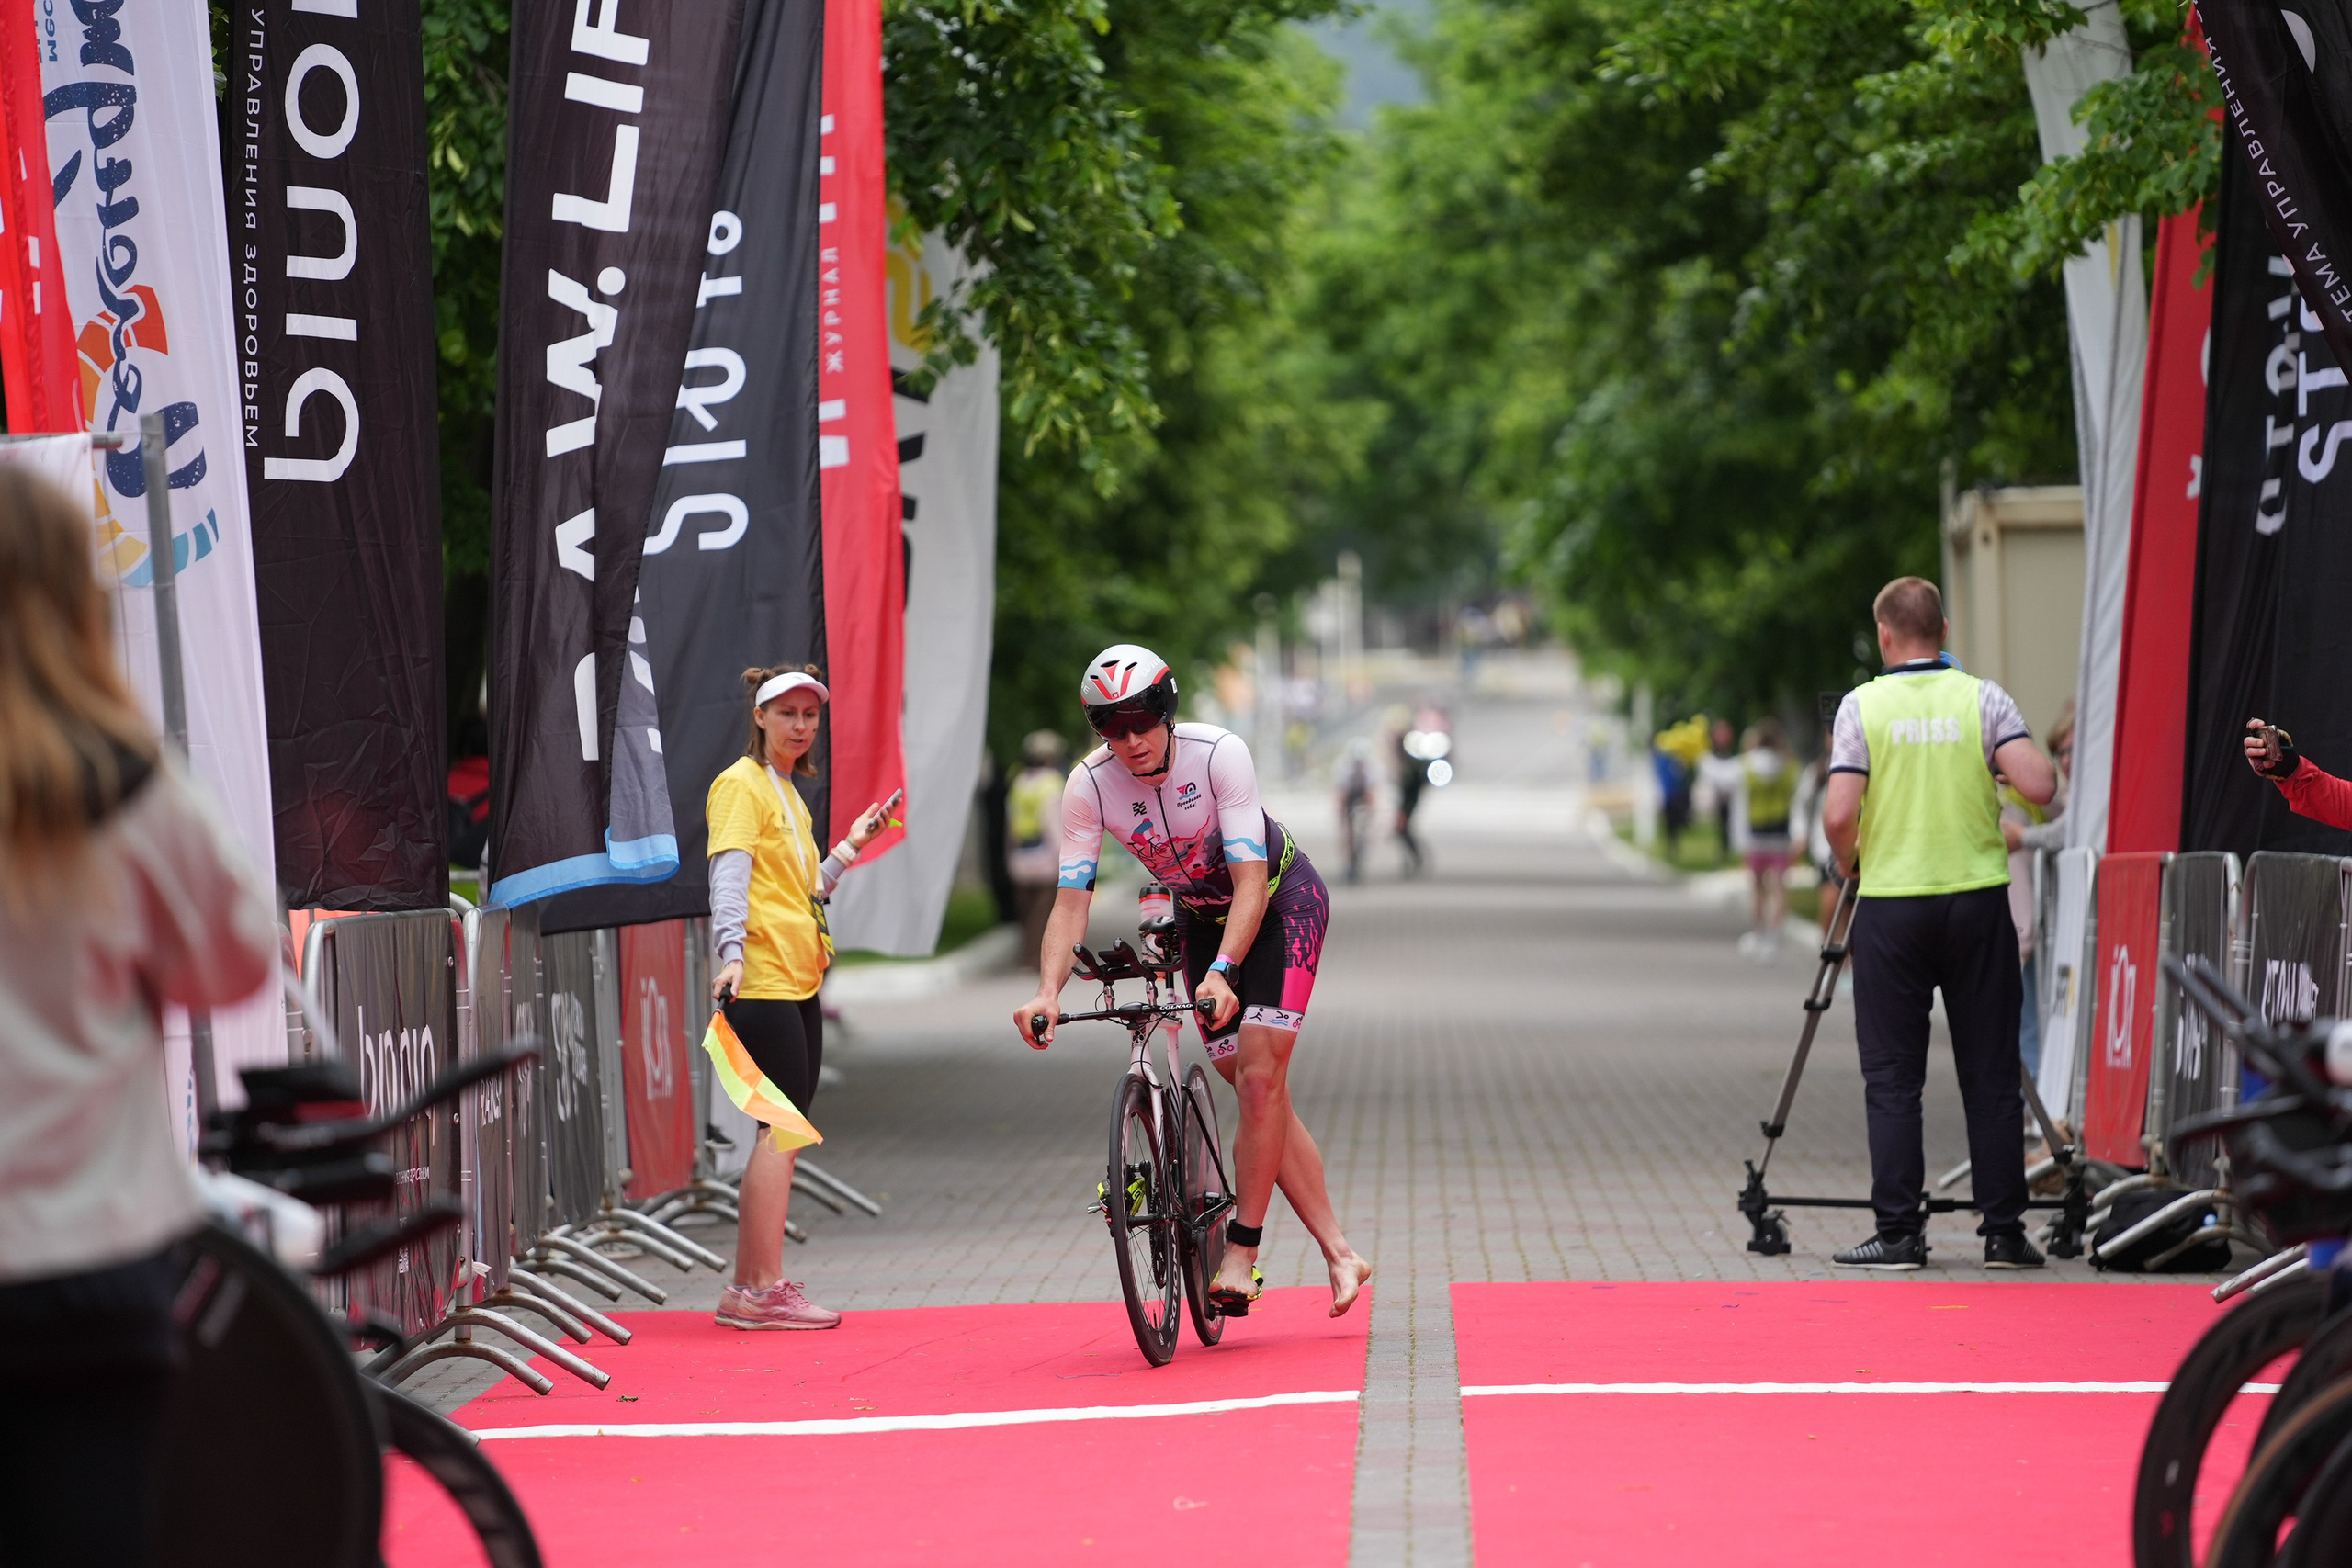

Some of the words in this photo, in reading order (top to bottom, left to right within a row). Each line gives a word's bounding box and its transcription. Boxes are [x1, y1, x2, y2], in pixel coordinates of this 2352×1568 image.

[245, 8, 265, 230] УПРАВЛЕНИЯ
[2205, 36, 2309, 239] УПРАВЛЕНИЯ
[243, 244, 260, 448] ЗДОРОВЬЕМ
[821, 246, 845, 375] ЖУРНАЛ
[1169, 1214, 1179, 1333] YNOLDS
